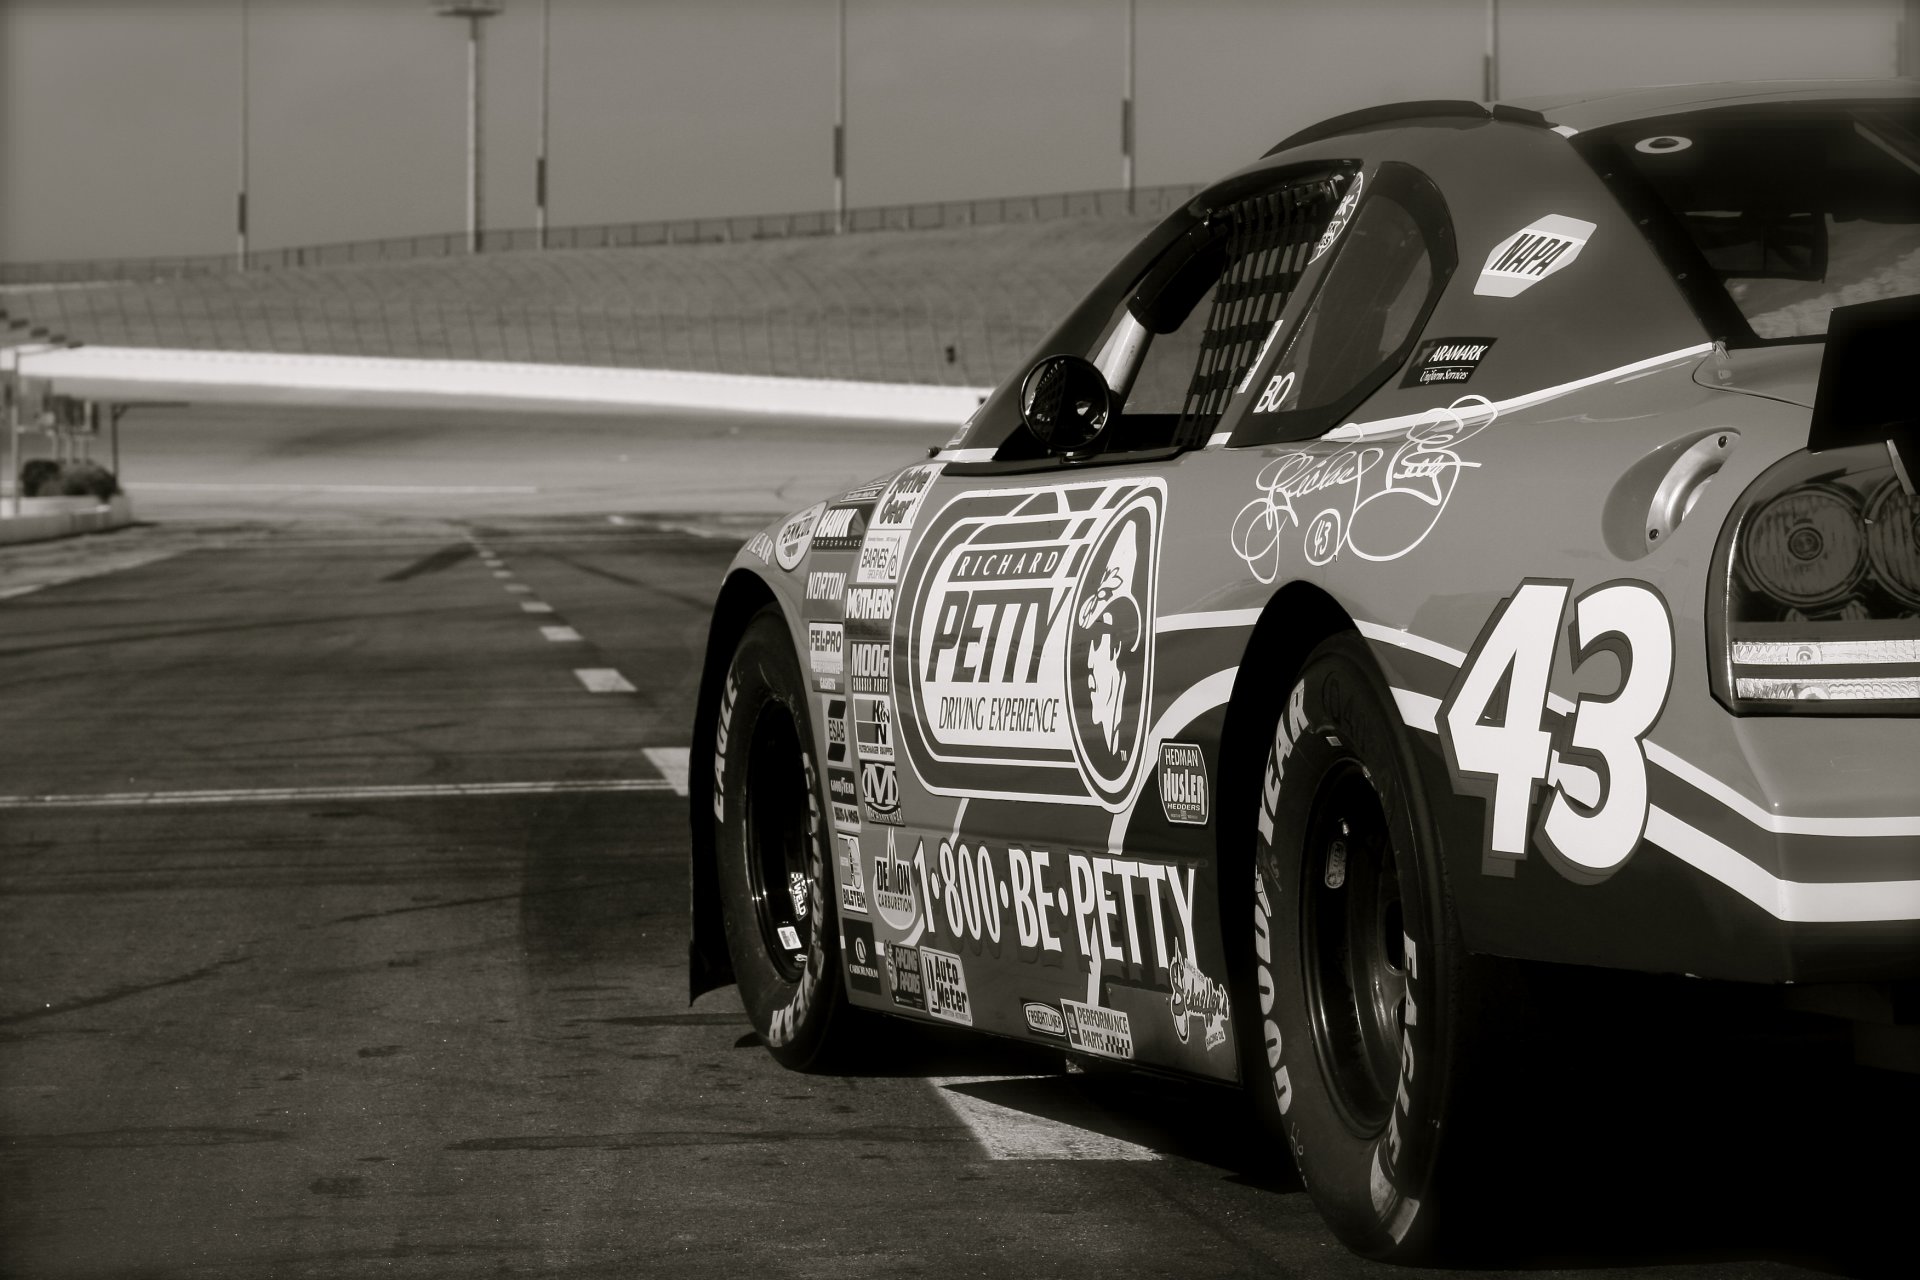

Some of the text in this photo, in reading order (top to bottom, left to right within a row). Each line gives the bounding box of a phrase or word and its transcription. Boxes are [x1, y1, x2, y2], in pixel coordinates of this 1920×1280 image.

[1490, 233, 1573, 276] NAPA
[1428, 345, 1488, 362] ARAMARK
[1420, 369, 1468, 384] Uniform Services
[1253, 371, 1295, 413] BO
[814, 509, 858, 537] HAWK
[812, 539, 862, 548] PERFORMANCE
[1314, 519, 1332, 557] 43
[861, 547, 889, 568] BARNES
[957, 552, 1059, 576] RICHARD
[806, 572, 847, 600] NORTON
[845, 588, 895, 619] MOTHERS
[925, 587, 1073, 683] PETTY
[851, 643, 889, 677] MOOG
[853, 677, 888, 692] CHASSIS PARTS
[939, 696, 1059, 732] DRIVING EXPERIENCE
[1448, 584, 1672, 869] 43
[828, 719, 846, 742] ESAB
[713, 673, 739, 824] EAGLE
[1164, 748, 1199, 767] HEDMAN
[1163, 767, 1205, 815] HUSLER
[1167, 803, 1201, 811] HEDDERS
[793, 882, 806, 916] WELD
[843, 888, 867, 909] BILSTEIN
[849, 963, 879, 979] CARBORUNDUM
[895, 947, 918, 972] RACING
[935, 955, 959, 985] Auto
[936, 981, 967, 1013] Meter
[1027, 1009, 1063, 1030] FREIGHTLINER
[1077, 1006, 1129, 1035] PERFORMANCE
[1082, 1029, 1104, 1051] PARTS
